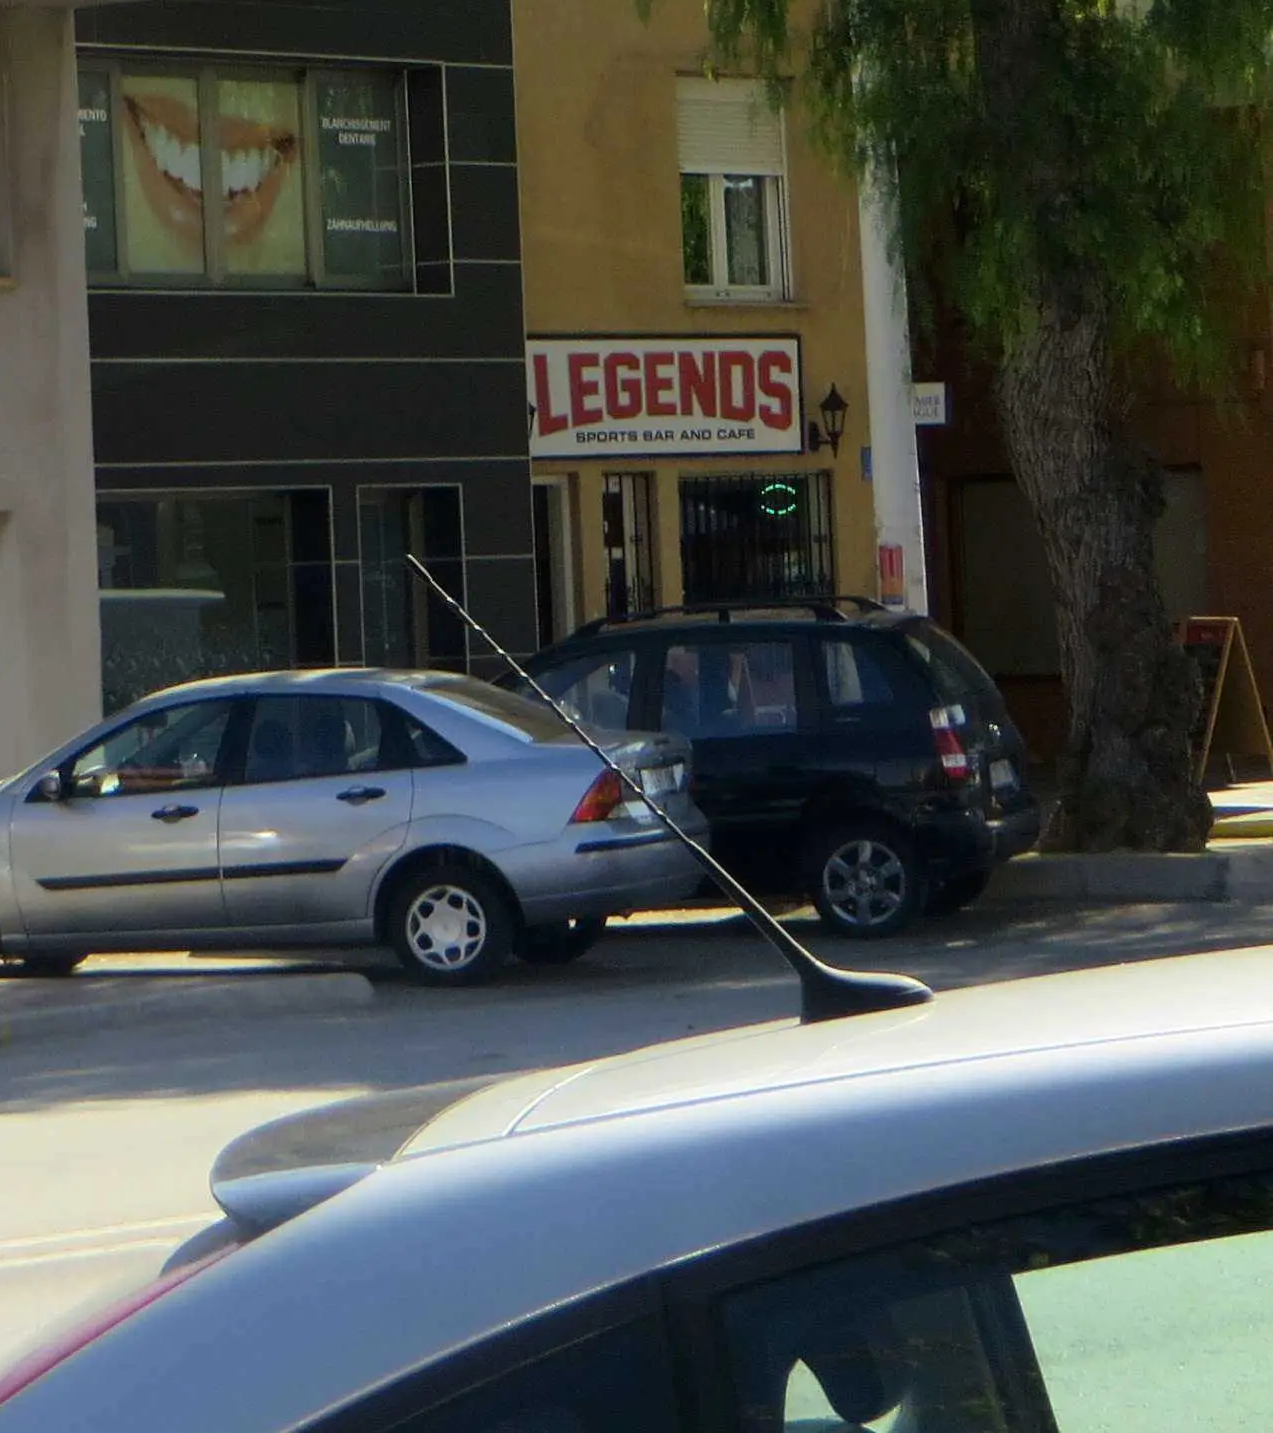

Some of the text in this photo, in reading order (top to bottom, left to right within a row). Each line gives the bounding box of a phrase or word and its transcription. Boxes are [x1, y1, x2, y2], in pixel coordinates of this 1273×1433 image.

[532, 351, 793, 437] LEGENDS
[576, 428, 755, 444] SPORTS BAR AND CAFE
